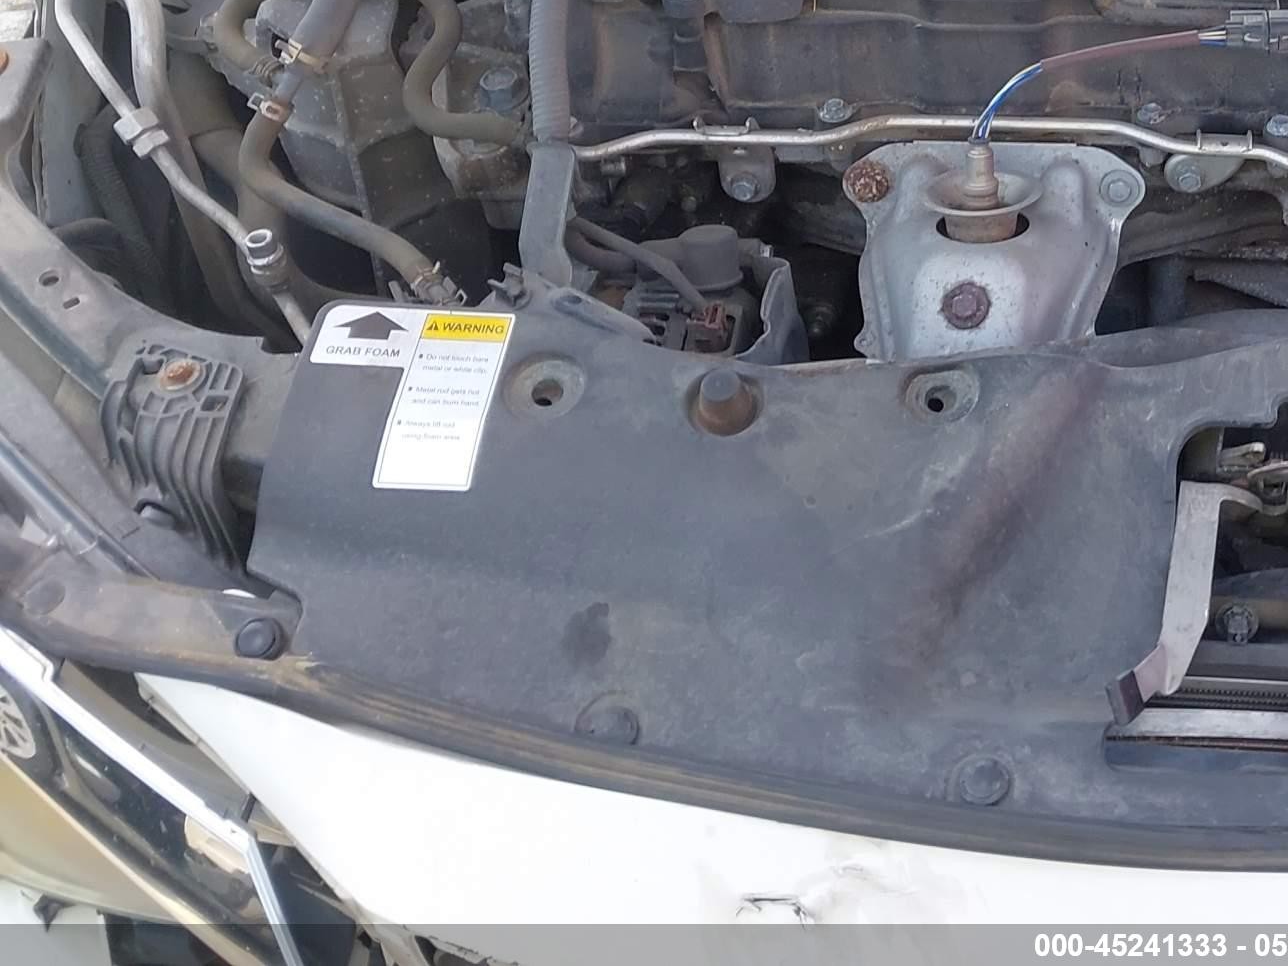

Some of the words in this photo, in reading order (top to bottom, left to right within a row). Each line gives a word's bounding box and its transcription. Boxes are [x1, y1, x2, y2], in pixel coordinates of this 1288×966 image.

[442, 322, 504, 334] WARNING
[326, 345, 361, 356] GRAB
[364, 347, 400, 358] FOAM
